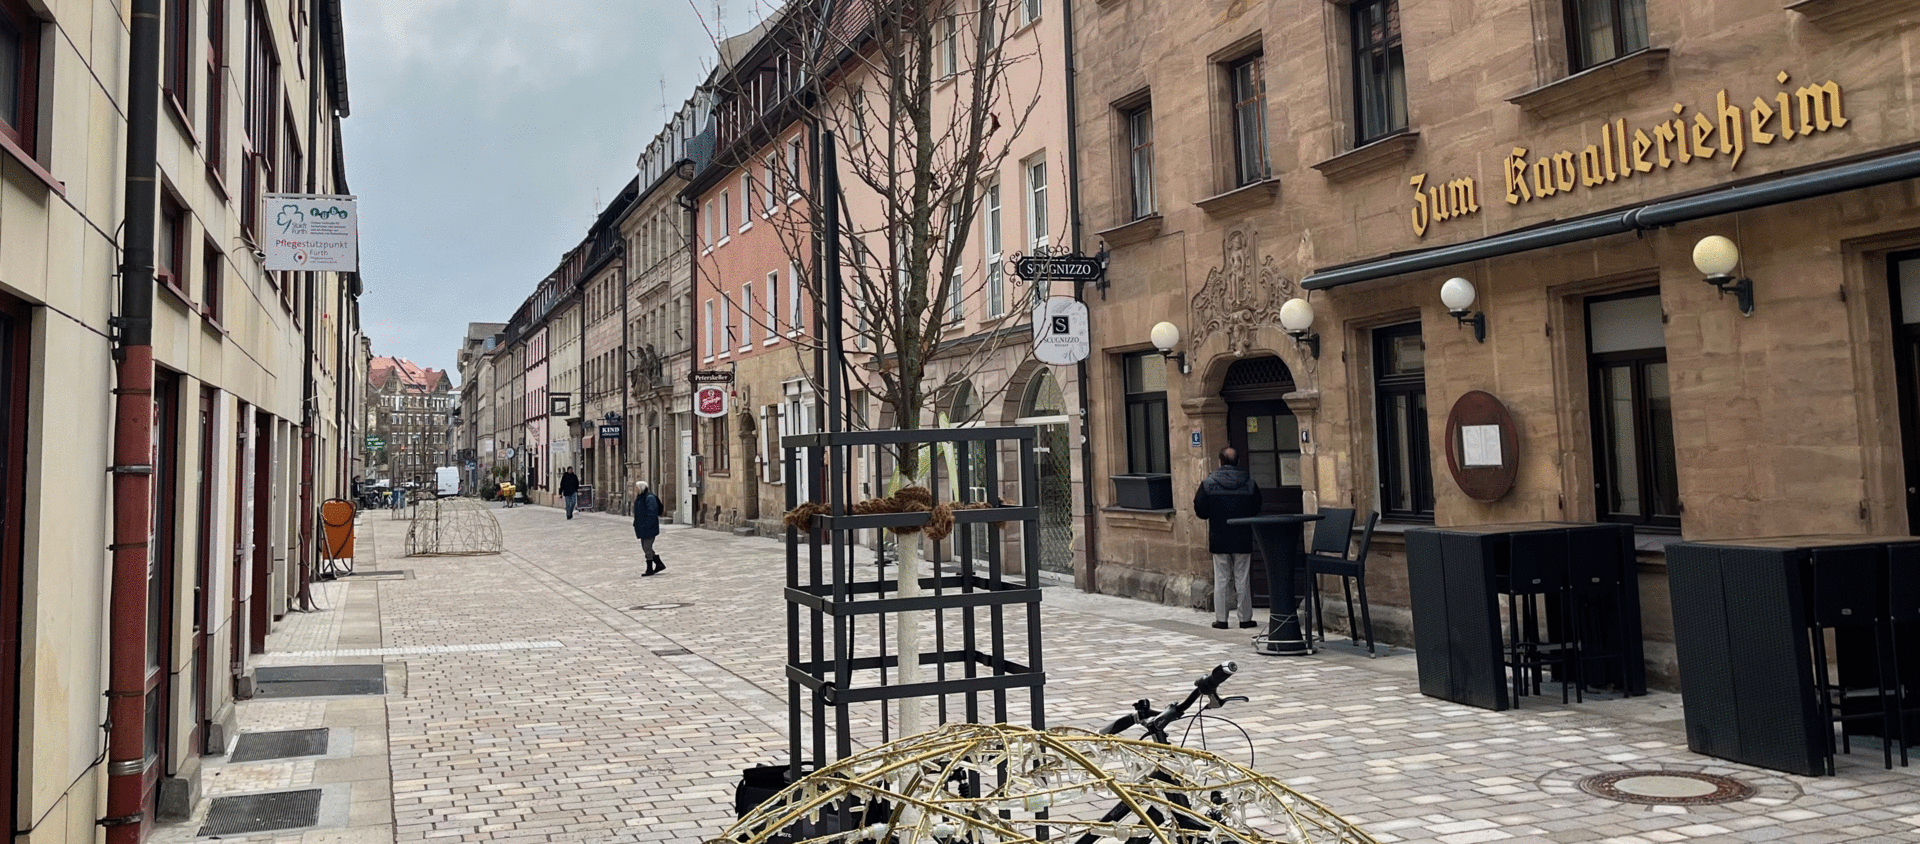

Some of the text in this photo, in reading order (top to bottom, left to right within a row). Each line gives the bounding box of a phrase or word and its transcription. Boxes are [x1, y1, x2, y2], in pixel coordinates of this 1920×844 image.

[1410, 70, 1849, 237] Zum Kavallerieheim
[1027, 263, 1092, 275] SCUGNIZZO
[1055, 318, 1067, 333] S
